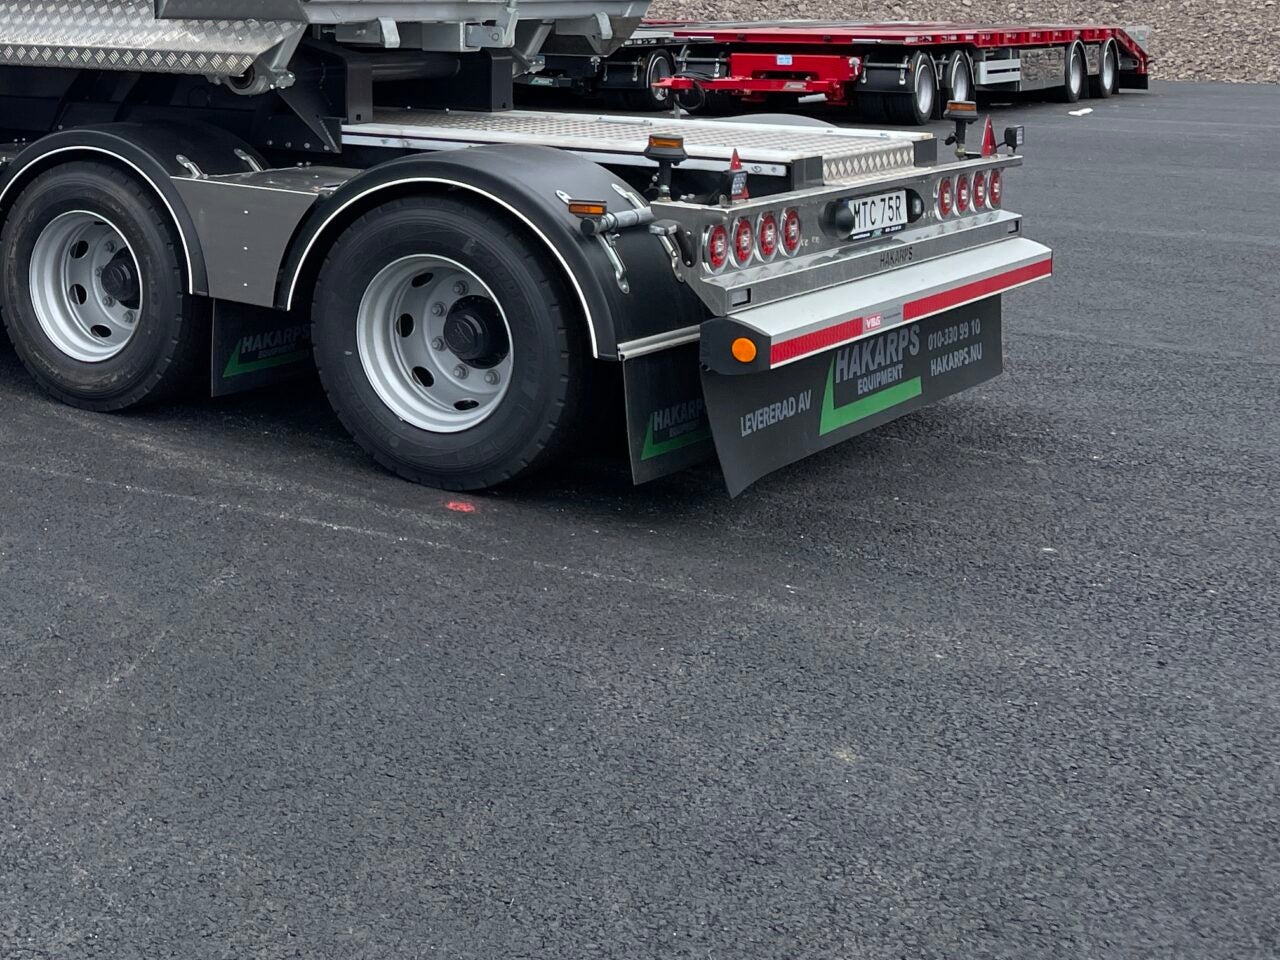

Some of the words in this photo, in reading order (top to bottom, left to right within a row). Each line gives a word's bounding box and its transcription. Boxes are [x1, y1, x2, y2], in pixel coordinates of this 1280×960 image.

[853, 200, 876, 230] MTC
[880, 195, 902, 224] 75R
[880, 246, 913, 268] HAKARPS
[927, 326, 958, 351] 010-330
[959, 322, 969, 340] 99
[970, 318, 981, 337] 10
[835, 324, 920, 384] HAKARPS
[930, 342, 983, 377] HAKARPS.NU
[857, 363, 904, 395] EQUIPMENT
[653, 398, 705, 432] HAKARP
[740, 396, 796, 438] LEVERERAD
[798, 389, 812, 414] AV
